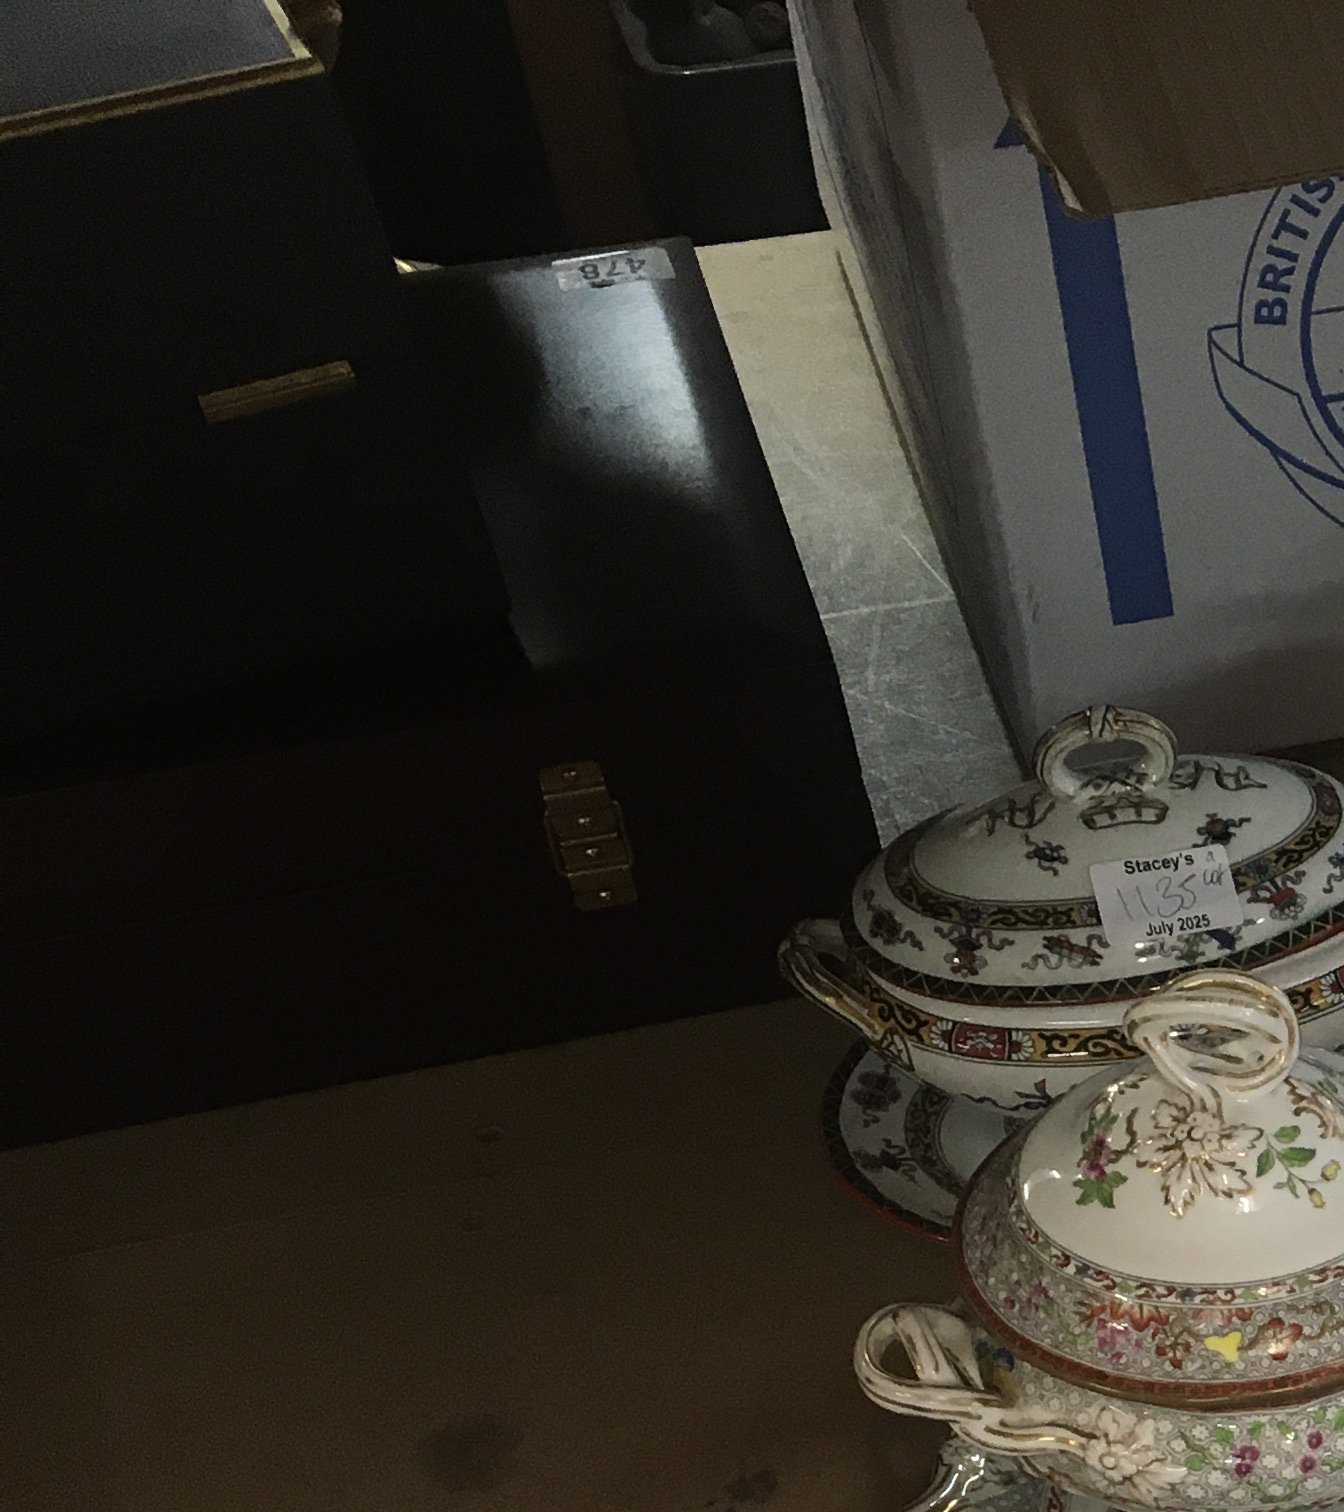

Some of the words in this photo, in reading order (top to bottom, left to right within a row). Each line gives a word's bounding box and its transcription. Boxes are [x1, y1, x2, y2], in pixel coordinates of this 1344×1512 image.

[1123, 852, 1195, 875] Stacey's
[1116, 873, 1197, 922] 1135
[1146, 922, 1174, 937] July
[1177, 914, 1211, 931] 2025
